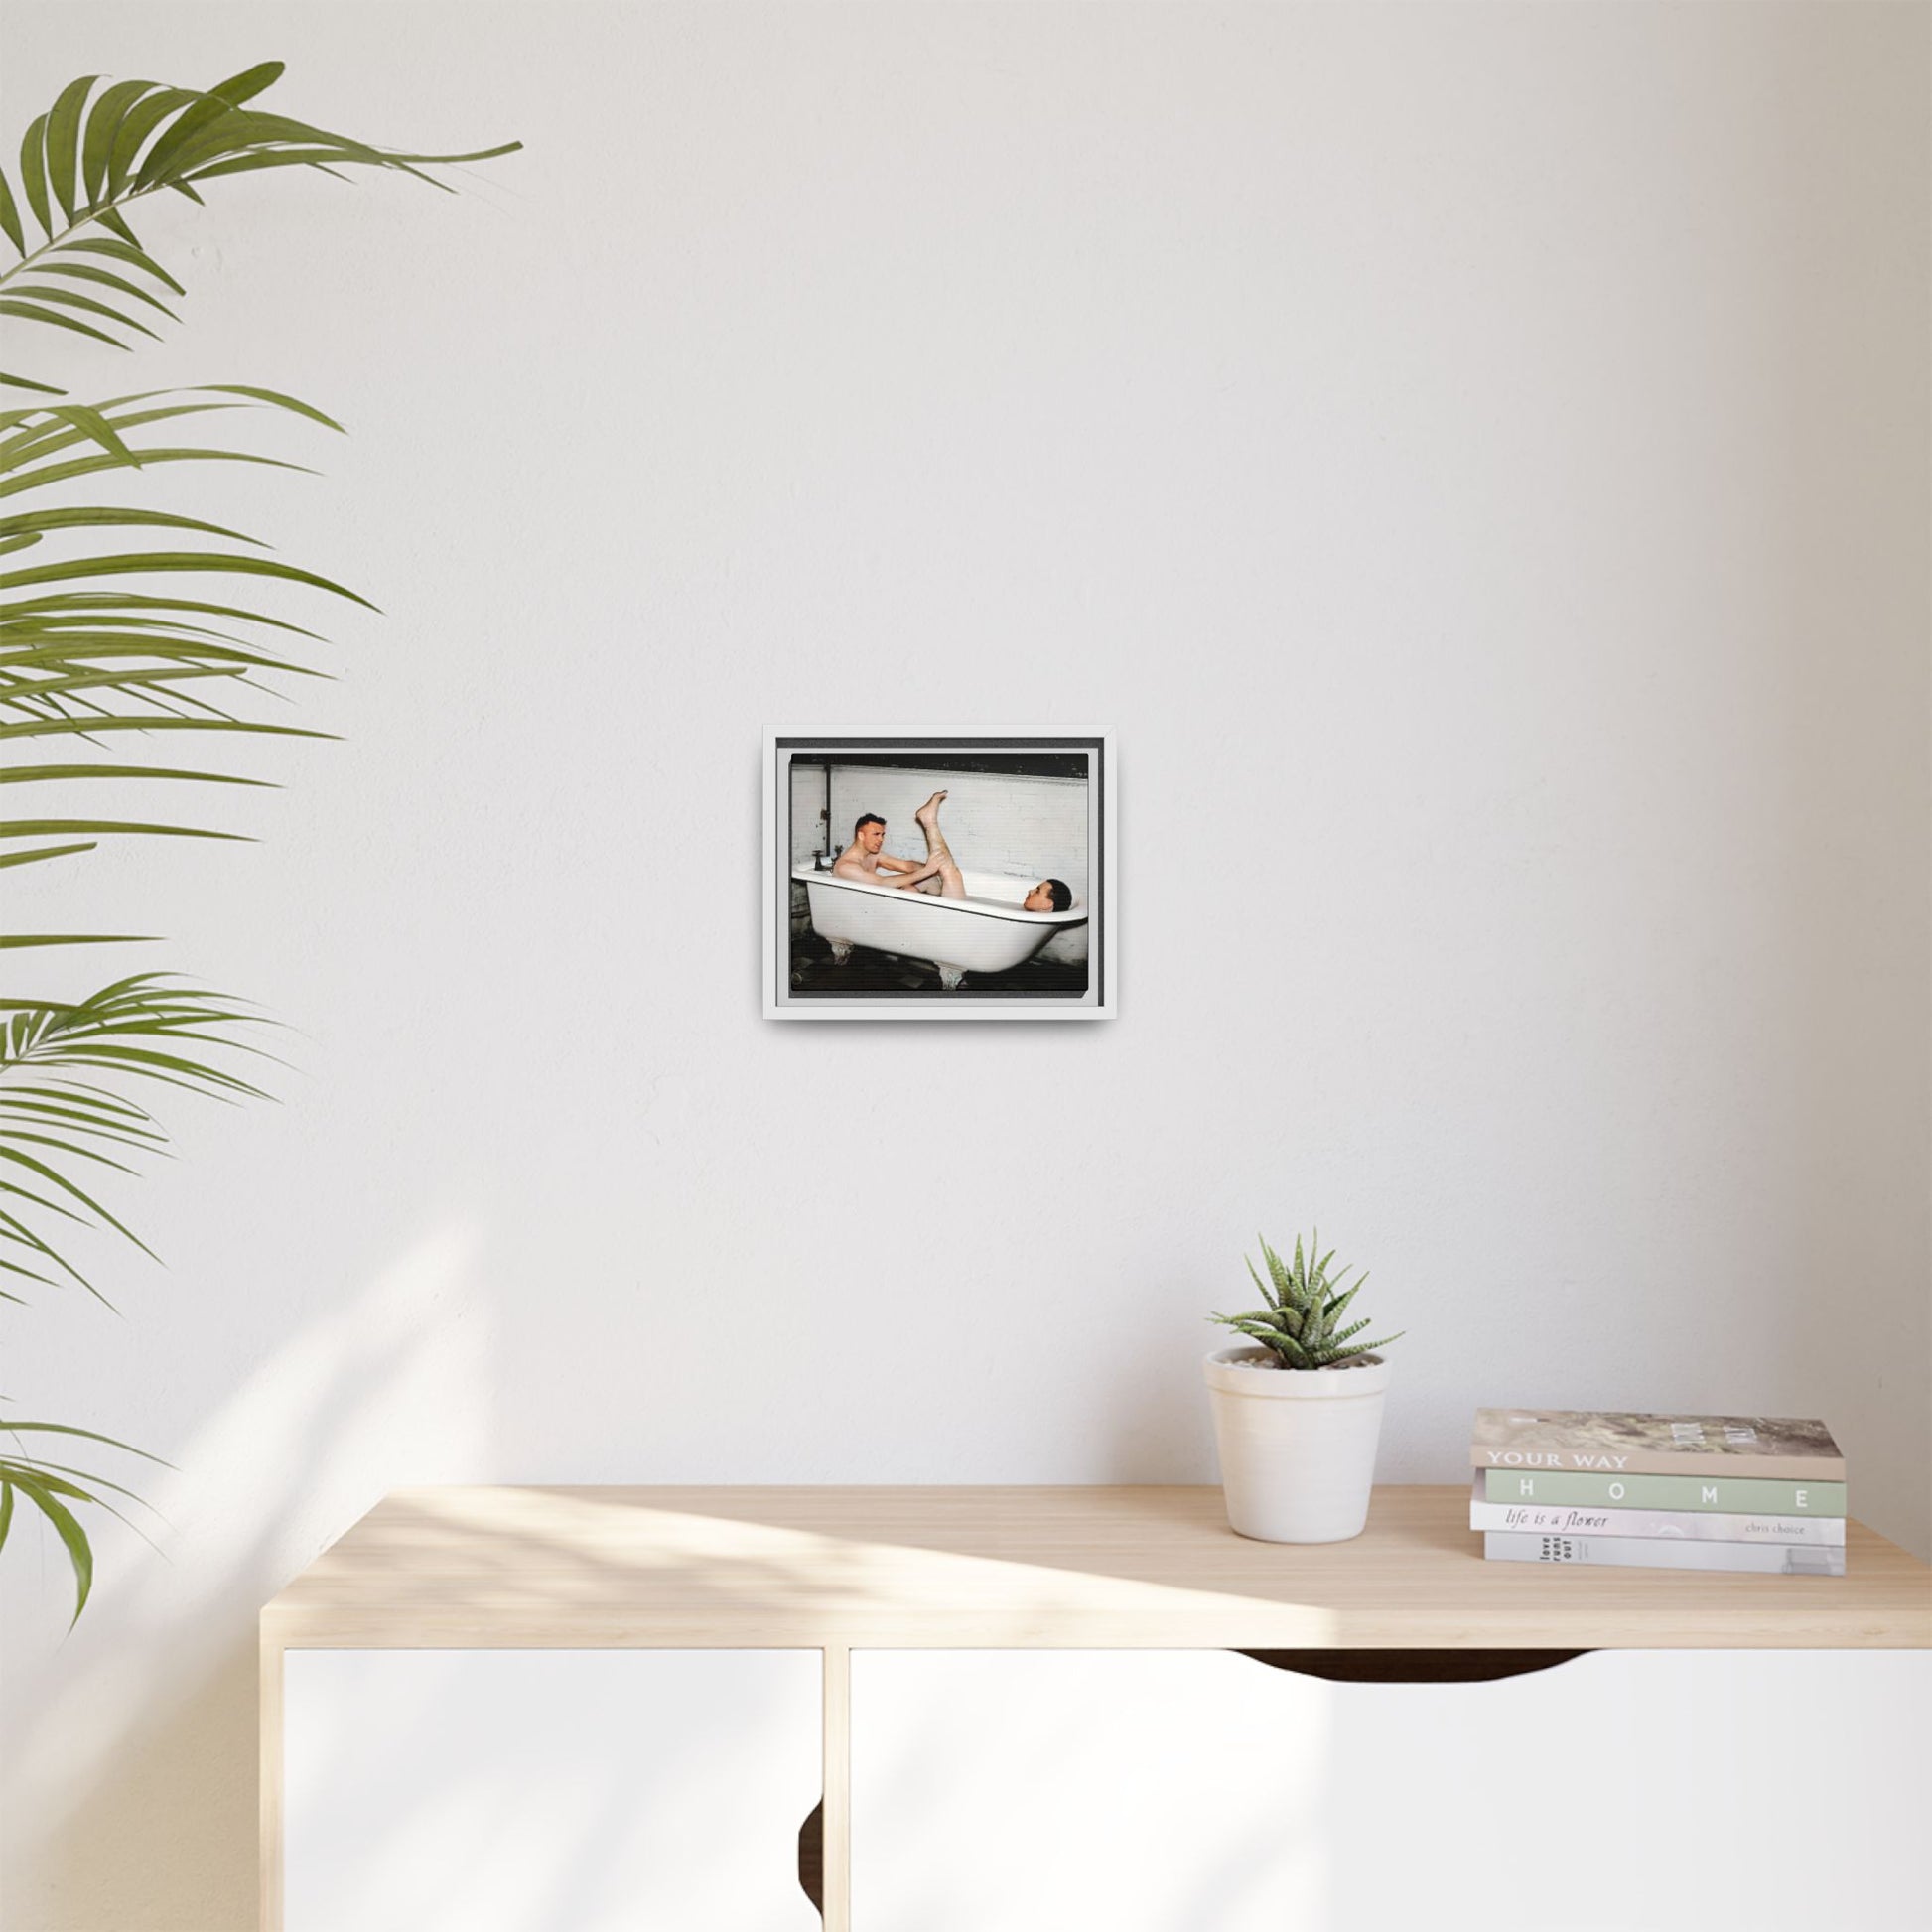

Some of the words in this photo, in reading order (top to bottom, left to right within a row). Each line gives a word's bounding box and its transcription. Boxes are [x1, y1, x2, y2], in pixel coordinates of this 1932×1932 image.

[1488, 1451, 1562, 1466] YOUR
[1574, 1454, 1628, 1468] WAY
[1506, 1508, 1528, 1528] life
[1534, 1514, 1546, 1525] is
[1551, 1516, 1560, 1525] a
[1563, 1511, 1609, 1531] flower
[1745, 1522, 1769, 1534] chris
[1772, 1523, 1805, 1535] choice
[1540, 1538, 1550, 1560] love
[1563, 1540, 1572, 1559] out
